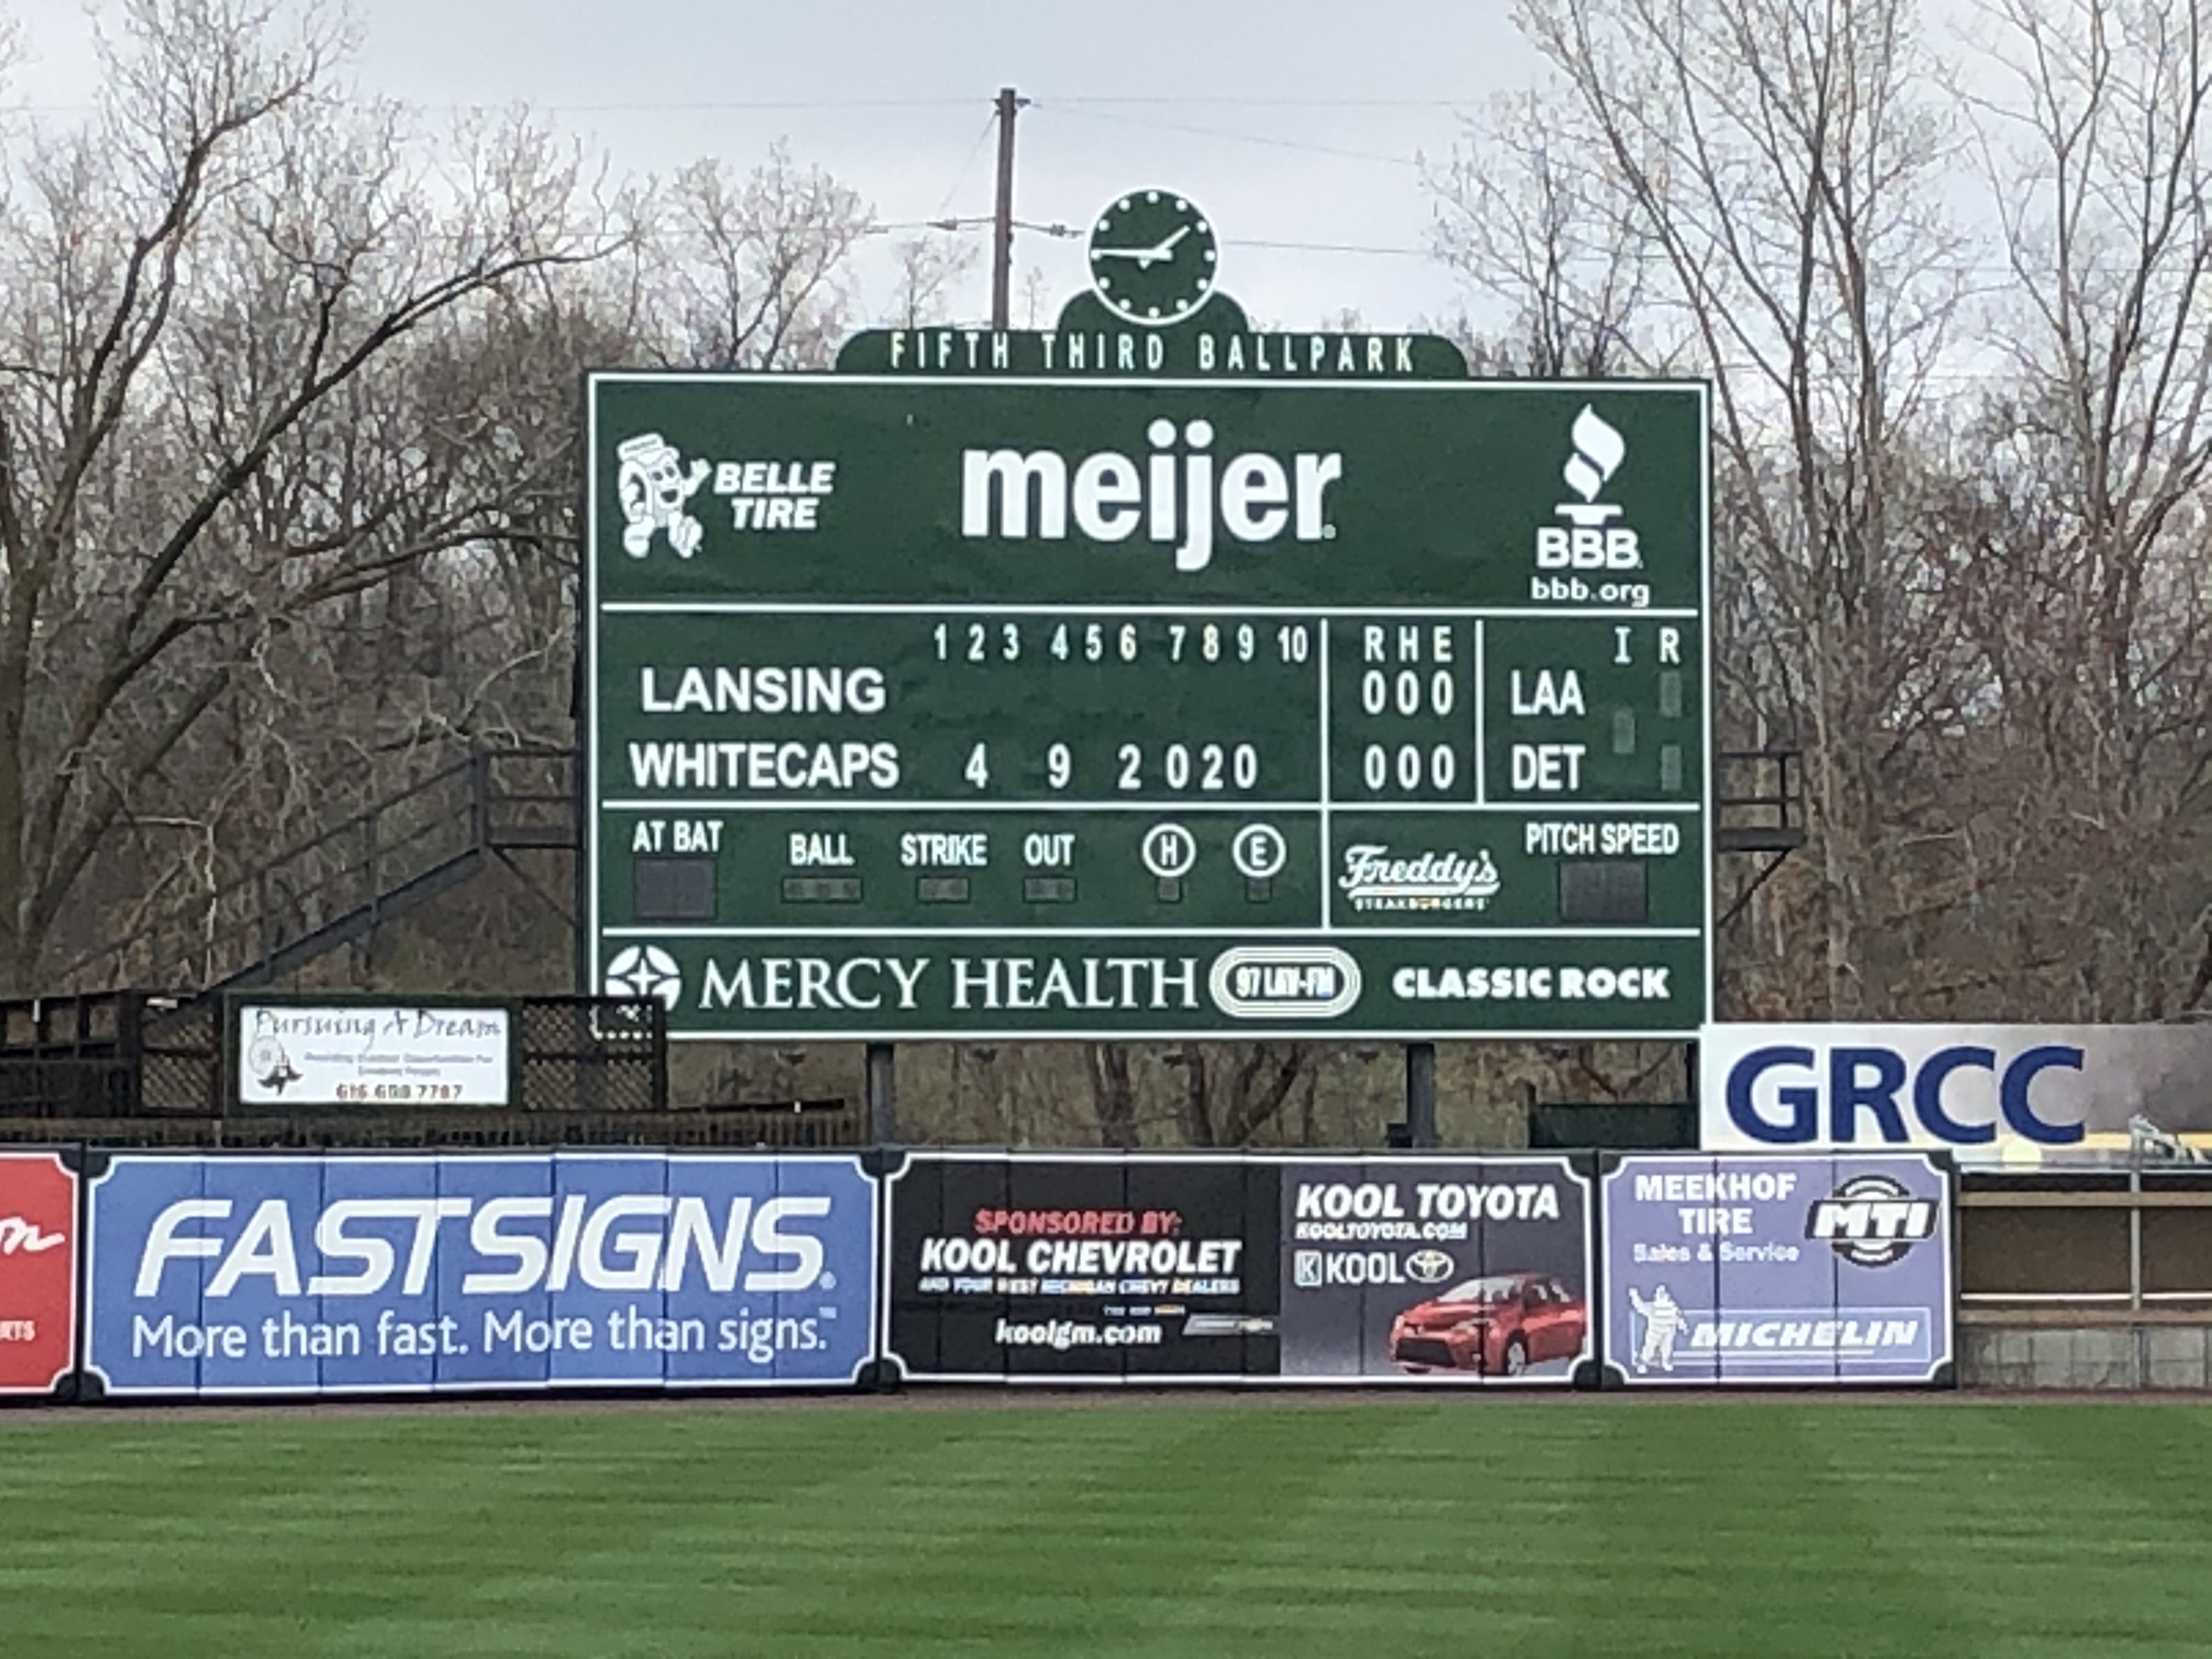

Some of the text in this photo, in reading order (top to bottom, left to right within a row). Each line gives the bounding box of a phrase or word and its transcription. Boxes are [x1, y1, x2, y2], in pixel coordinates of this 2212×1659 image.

[892, 329, 1416, 371] FIFTH THIRD BALLPARK
[711, 462, 835, 494] BELLE
[963, 420, 1341, 571] meijer
[732, 498, 819, 528] TIRE
[1537, 528, 1641, 568] BBB
[1532, 577, 1649, 609] bbb.org
[935, 624, 1307, 662] 1 2 3 4 5 6 7 8 9 10
[1615, 627, 1679, 663] I R
[642, 668, 885, 712] LANSING
[1512, 670, 1584, 714] LAA
[629, 743, 899, 788] WHITECAPS
[966, 744, 988, 788] 4
[1049, 744, 1070, 788] 9
[1513, 744, 1585, 789] DET
[633, 821, 723, 851] AT BAT
[791, 833, 854, 865] BALL
[901, 833, 986, 865] STRIKE
[1025, 834, 1074, 865] OUT
[1160, 835, 1177, 865] H
[1250, 837, 1267, 866] E
[1527, 822, 1679, 854] PITCH SPEED
[1338, 845, 1498, 896] Freddy's
[699, 958, 1198, 1008] MERCY HEALTH
[1236, 966, 1260, 997] 97
[1393, 968, 1669, 998] CLASSIC ROCK
[256, 1008, 501, 1053] Pursuing A Dream
[1726, 1045, 2085, 1144] GRCC
[1296, 1184, 1559, 1220] KOOL TOYOTA
[1635, 1173, 1798, 1201] MEEKHOF
[975, 1209, 1182, 1235] SPONSORED BY:
[1295, 1222, 1468, 1241] KOOLTOYOTA.COM
[1679, 1208, 1753, 1234] TIRE
[1814, 1202, 1930, 1237] MTI
[135, 1195, 831, 1297] FASTSIGNS
[921, 1238, 1242, 1274] KOOL CHEVROLET
[1634, 1242, 1800, 1262] Sales & Service
[1326, 1252, 1406, 1283] KOOL
[133, 1305, 827, 1363] More than fast. More than signs.
[996, 1319, 1161, 1349] koolgm.com
[1691, 1321, 1918, 1347] MICHELIN
